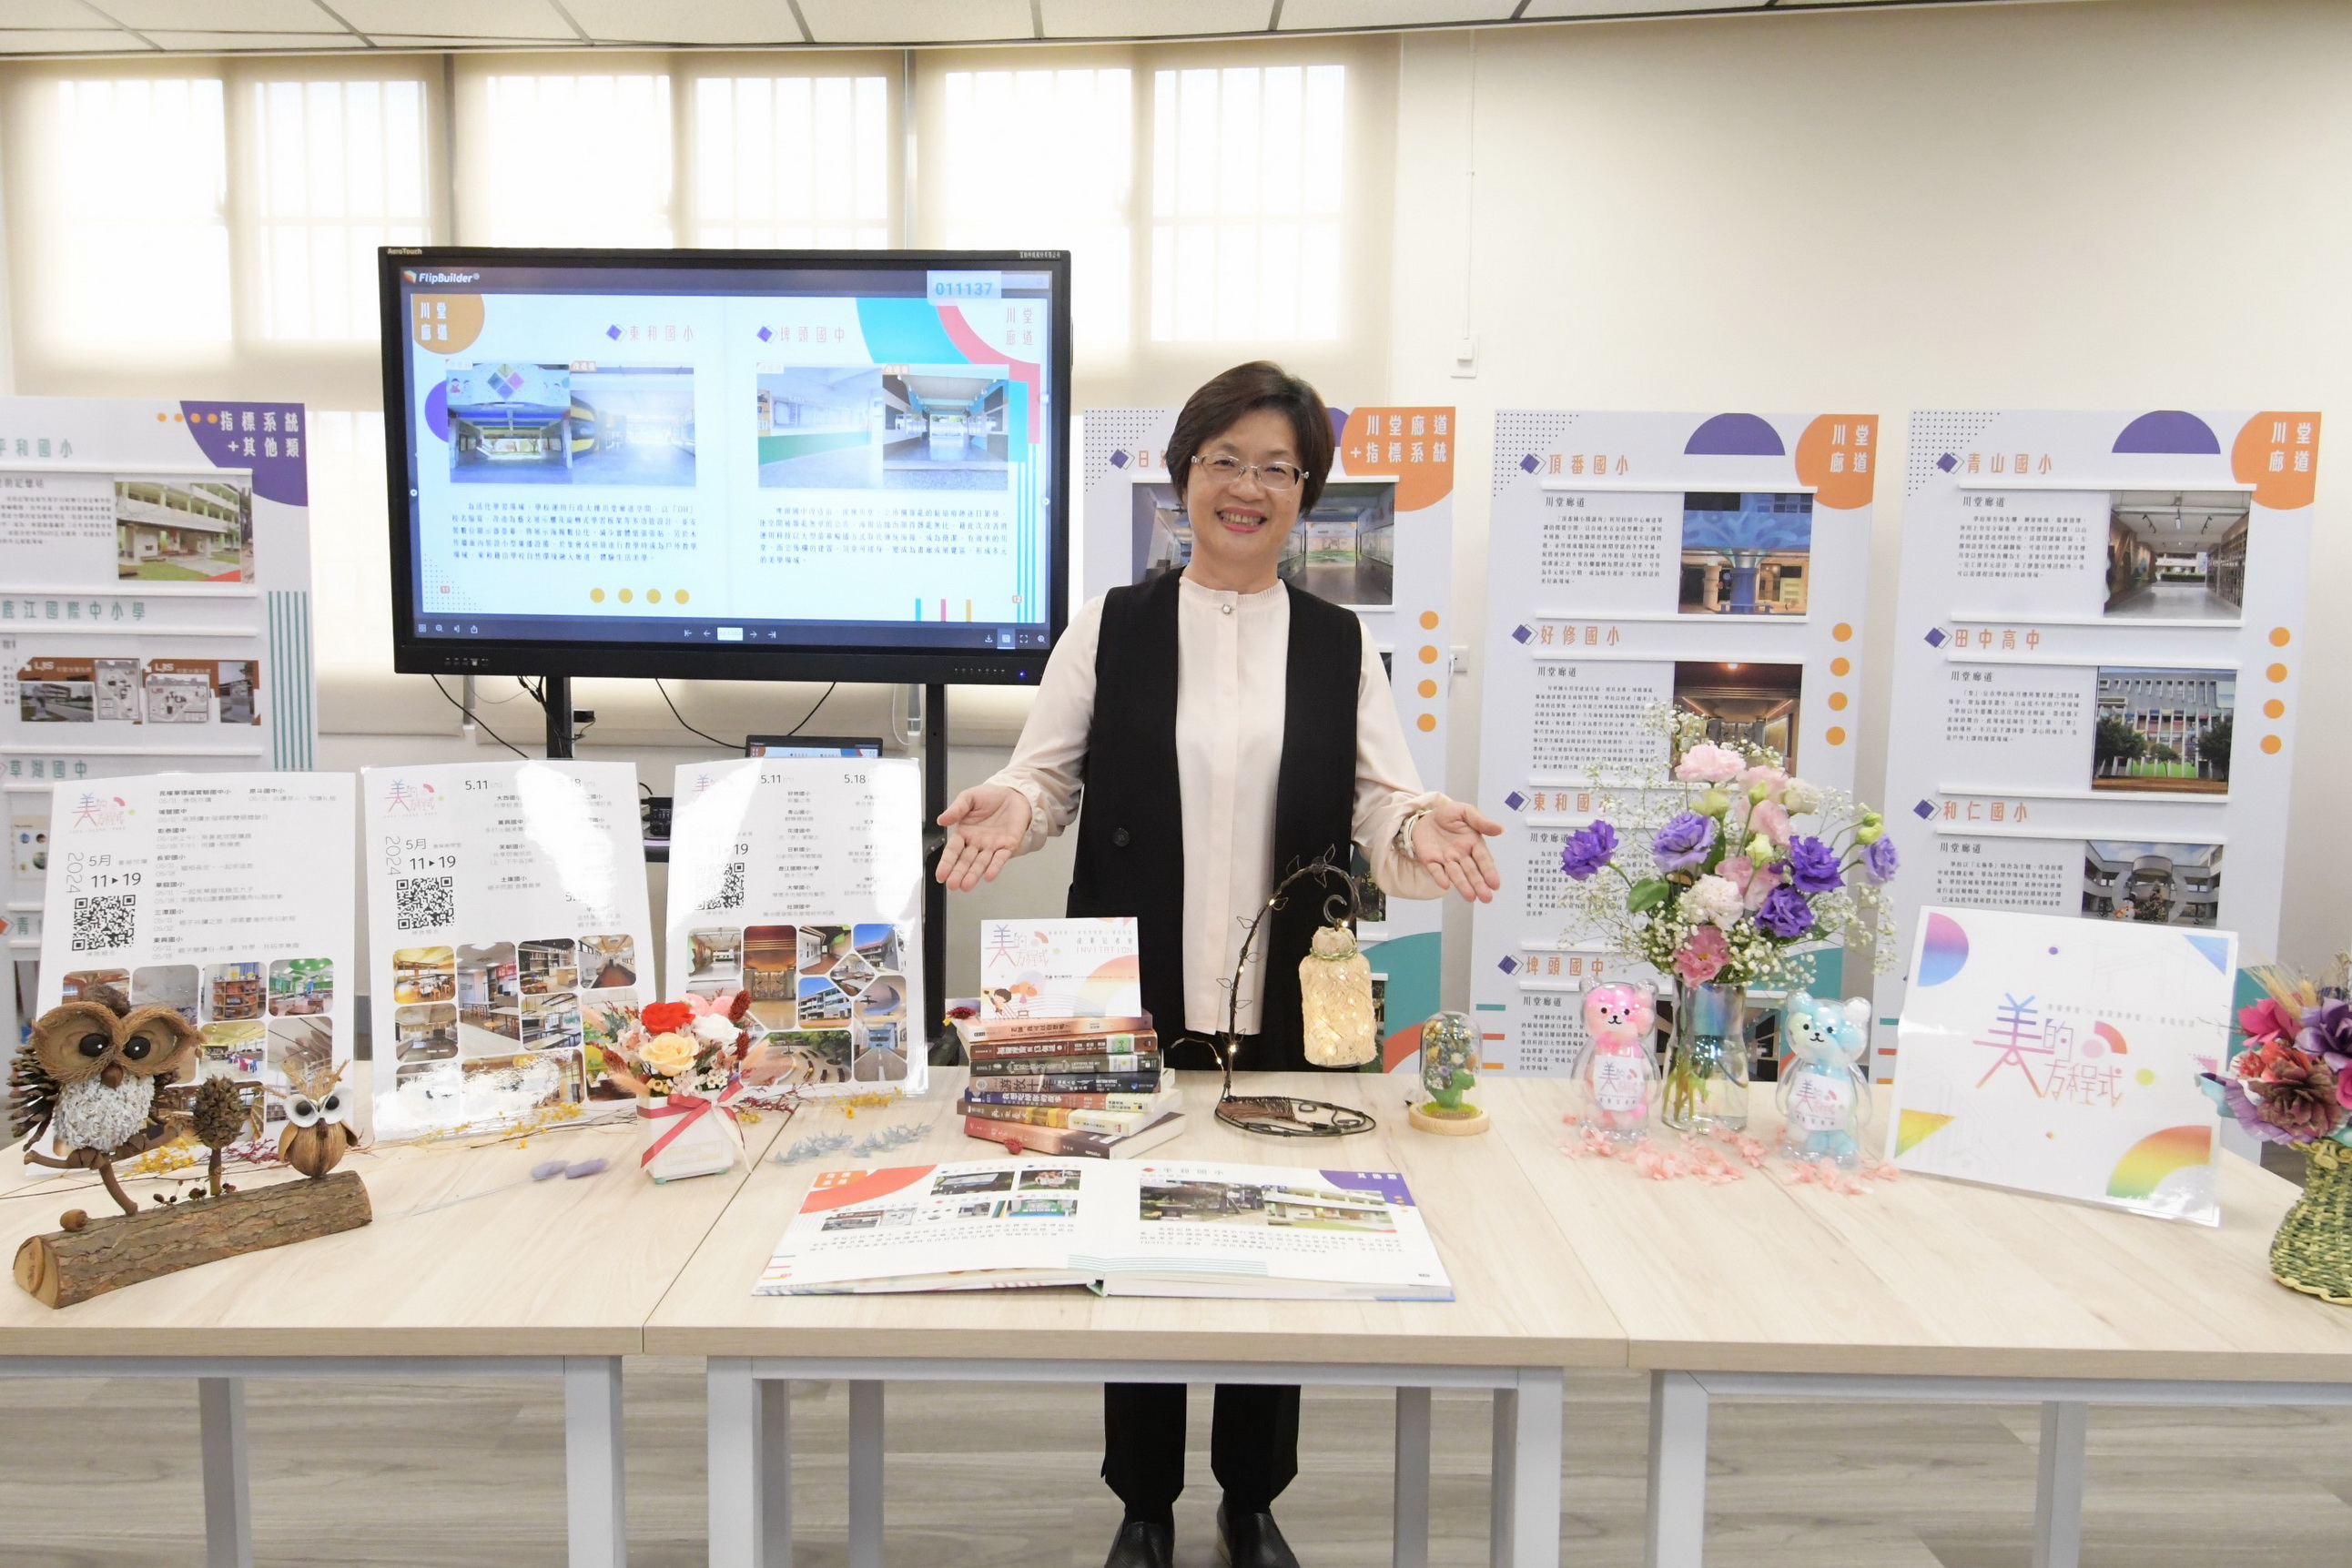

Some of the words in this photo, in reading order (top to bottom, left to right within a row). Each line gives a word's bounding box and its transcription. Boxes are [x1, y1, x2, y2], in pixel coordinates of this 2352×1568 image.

[935, 283, 993, 296] 011137
[421, 301, 447, 319] 川堂
[1006, 308, 1033, 324] 川堂
[629, 325, 694, 341] 東和國小
[780, 326, 845, 343] 埤頭國中
[1006, 329, 1033, 347] 廊道
[220, 411, 299, 432] 指標系統
[1366, 415, 1447, 436] 川堂廊道
[1831, 424, 1870, 447] 川堂
[2272, 421, 2312, 444] 川堂
[228, 437, 299, 458] +其他類
[1350, 441, 1447, 463] +指標系統
[1549, 454, 1628, 475] 頂番國小
[1830, 451, 1868, 474] 廊道
[1967, 452, 2052, 475] 青山國小
[2268, 450, 2309, 473] 廊道
[1545, 496, 1586, 509] 川堂廊道
[1962, 496, 2005, 509] 川堂廊道
[2, 602, 146, 621] 鹿江國際中小學
[1541, 624, 1619, 645] 好修國小
[1956, 629, 2040, 651] 田中高中
[1537, 666, 1577, 678] 川堂廊道
[1951, 671, 1993, 683] 川堂廊道
[10, 760, 87, 778] 草湖國中
[464, 780, 489, 791] 5.11
[760, 774, 781, 784] 5.11
[844, 774, 867, 784] 5.18
[1942, 800, 2028, 823] 和仁國小
[405, 838, 427, 851] 5月
[733, 844, 749, 855] 19
[1940, 842, 1982, 855] 川堂廊道
[89, 854, 111, 866] 5月
[384, 836, 401, 876] 2024
[409, 857, 425, 871] 11
[438, 855, 456, 869] 19
[66, 852, 85, 894] 2024
[91, 875, 108, 888] 11
[122, 873, 142, 886] 19
[16, 917, 42, 935] 青
[1076, 946, 1133, 955] INVITATION
[1526, 956, 1605, 976] 埤頭國中
[1523, 996, 1562, 1007] 川堂廊道
[1972, 992, 2124, 1108] 美的方程式
